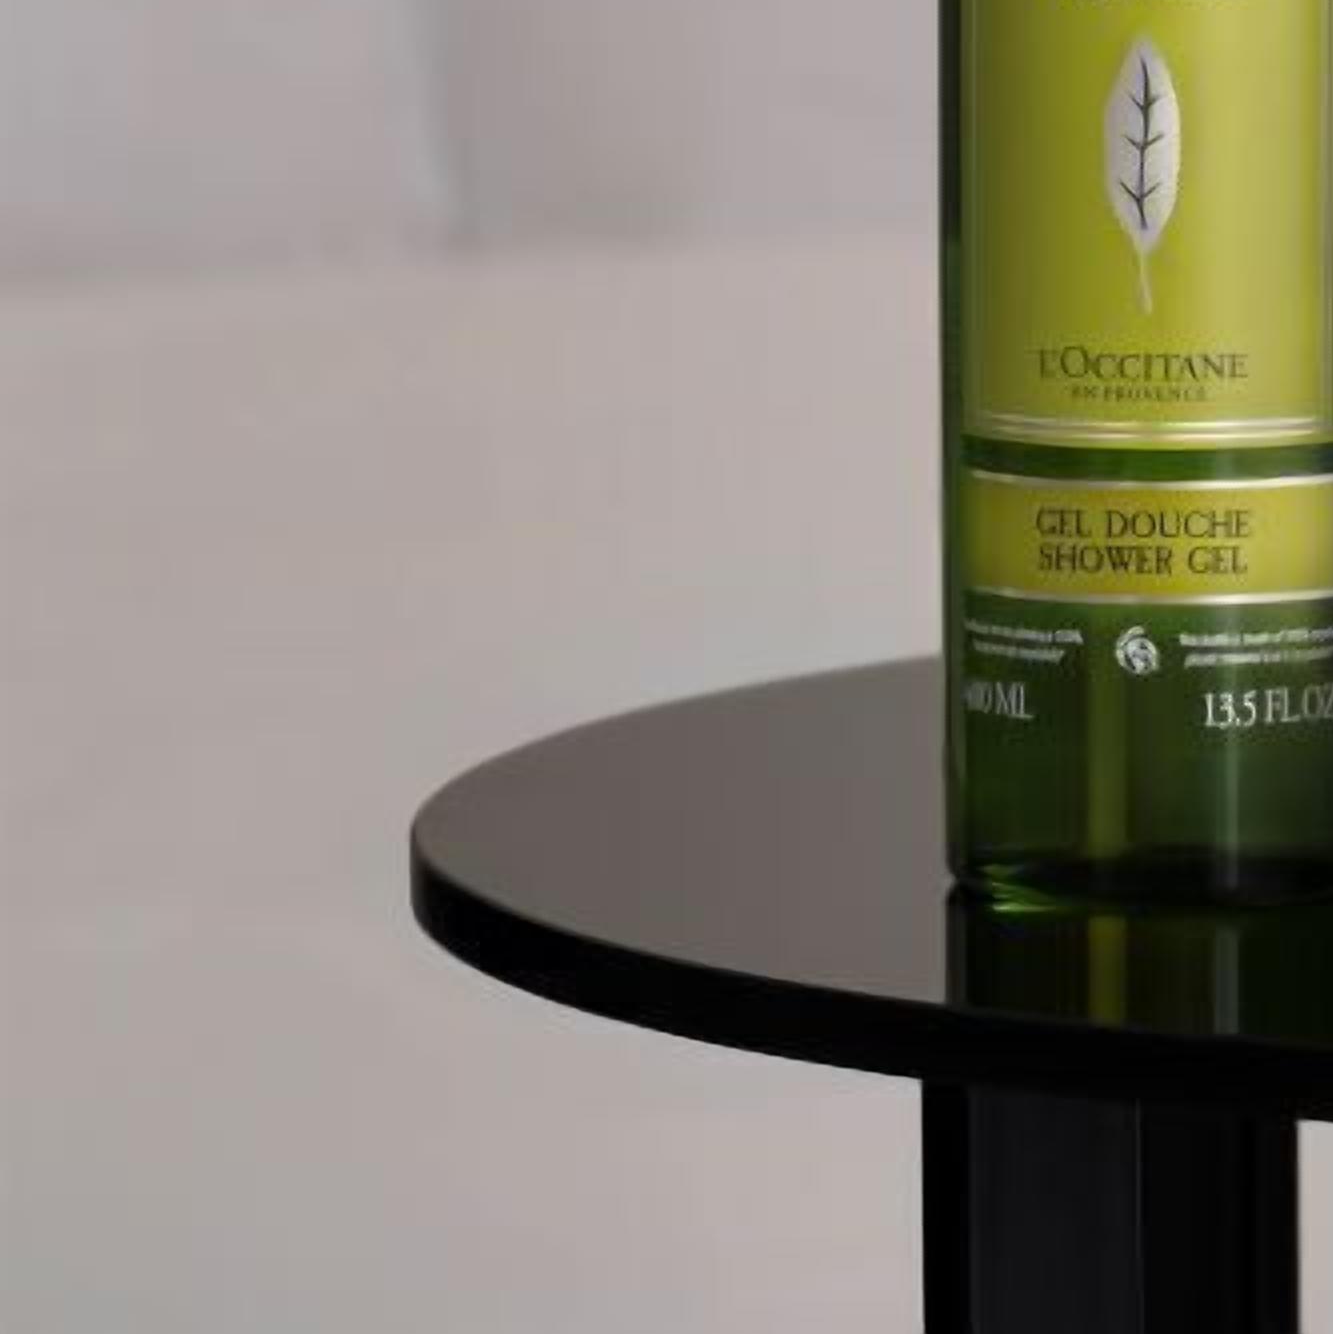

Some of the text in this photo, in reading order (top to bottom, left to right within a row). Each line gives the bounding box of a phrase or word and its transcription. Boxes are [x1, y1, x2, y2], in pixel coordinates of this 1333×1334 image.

[1036, 508, 1252, 539] GEL DOUCHE
[1039, 546, 1249, 574] SHOWER GEL
[966, 679, 992, 713] 00
